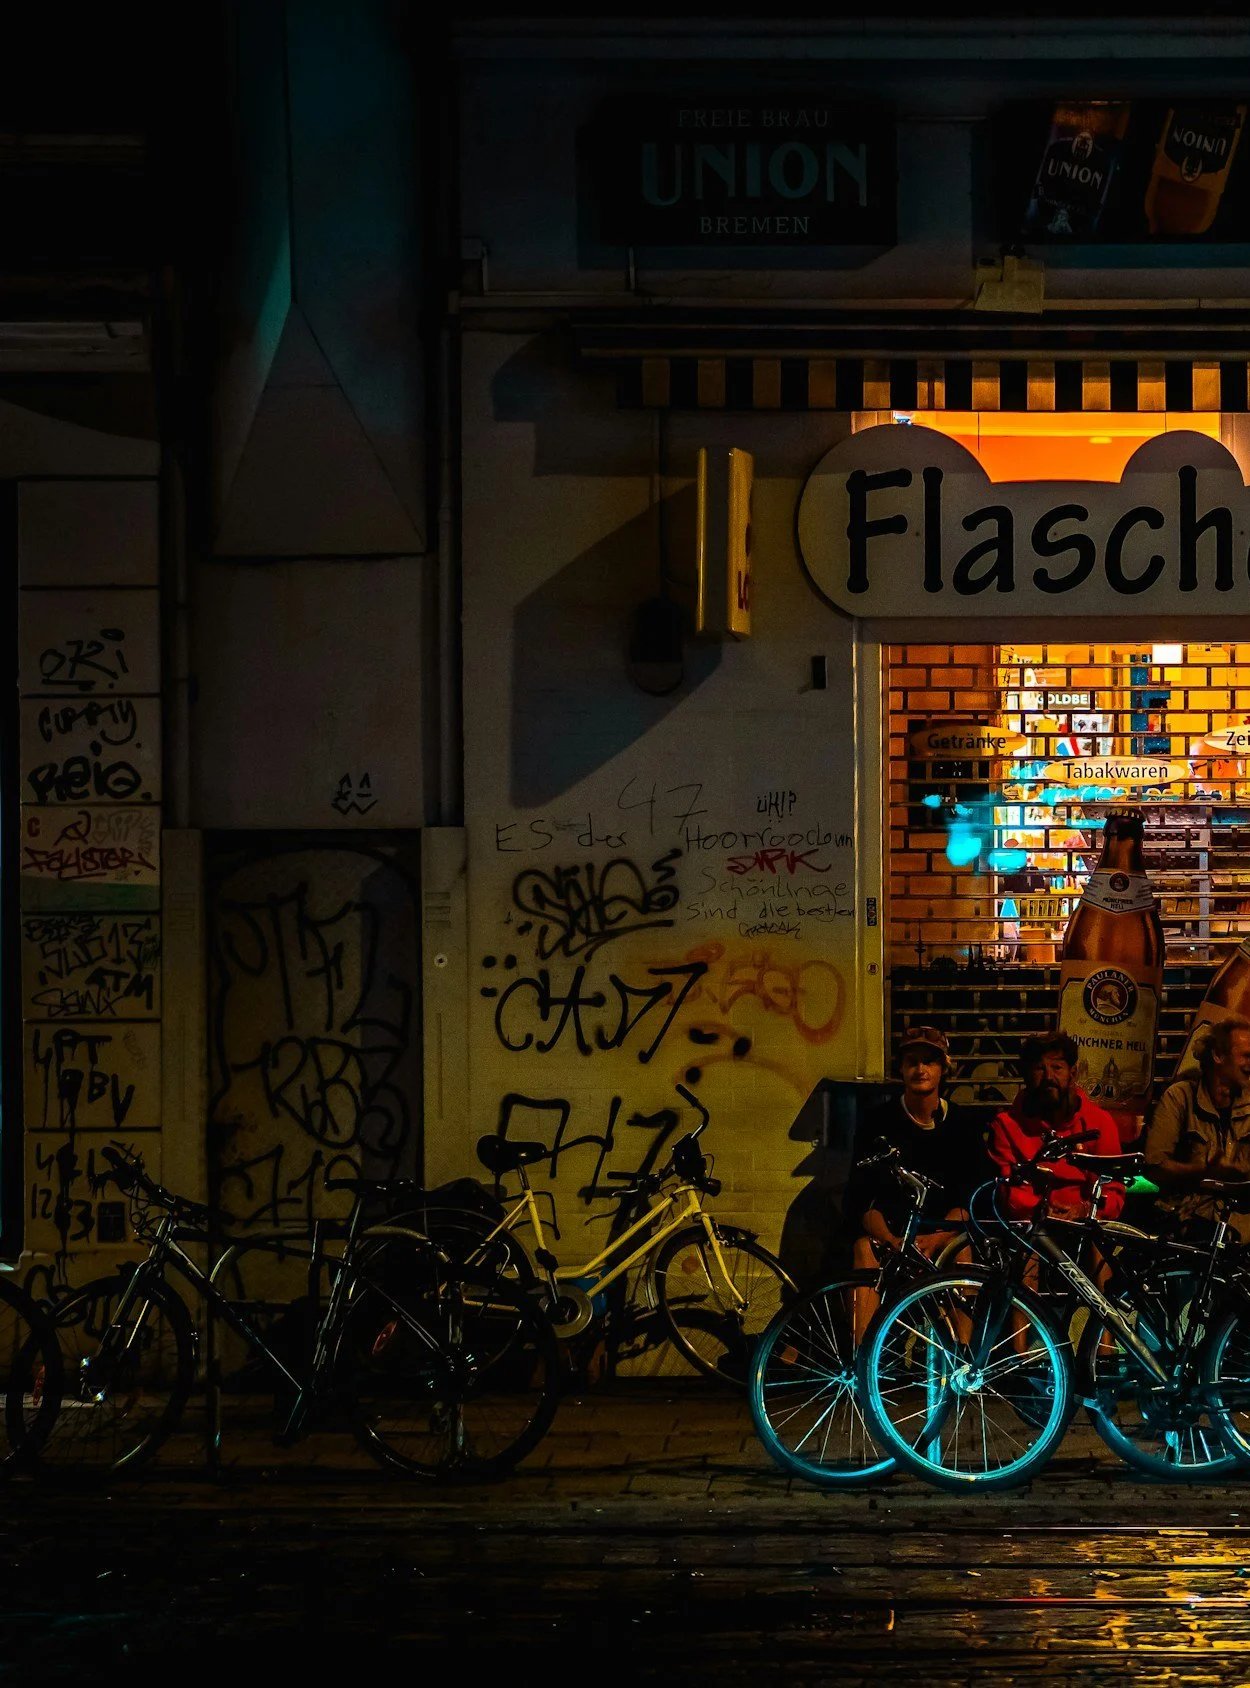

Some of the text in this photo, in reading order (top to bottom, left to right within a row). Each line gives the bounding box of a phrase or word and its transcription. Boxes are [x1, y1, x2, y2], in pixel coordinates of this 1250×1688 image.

[677, 108, 752, 128] FREIE
[640, 140, 868, 208] UNION
[1047, 157, 1104, 191] UNION
[699, 215, 810, 235] BREMEN
[927, 732, 1007, 749] Getränke
[1063, 762, 1169, 779] Tabakwaren
[1086, 970, 1135, 993] PAULANER
[1070, 1034, 1123, 1050] ÜNCHNER
